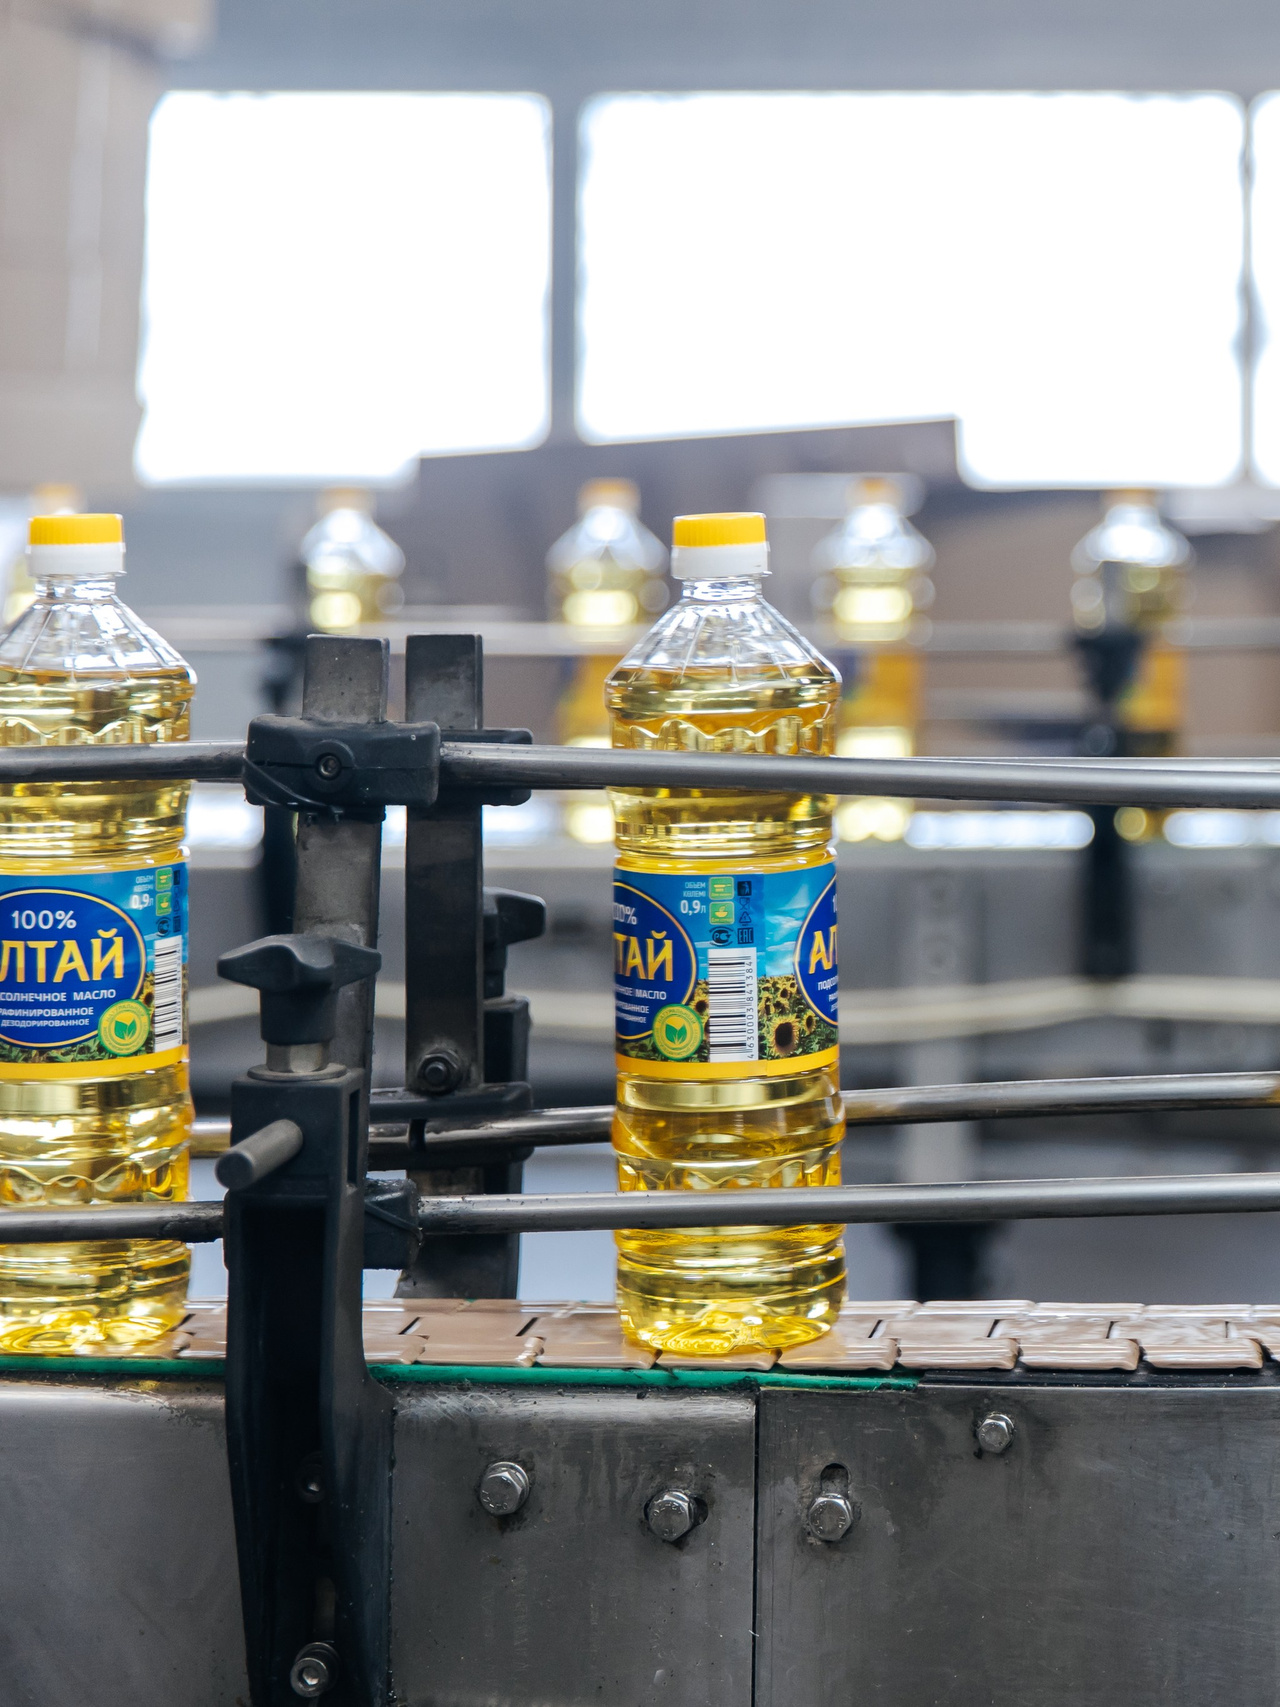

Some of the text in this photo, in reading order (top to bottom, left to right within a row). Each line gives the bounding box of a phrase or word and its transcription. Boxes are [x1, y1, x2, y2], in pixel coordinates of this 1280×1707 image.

[11, 910, 77, 930] 100%
[0, 928, 124, 983] ЛТАЙ
[613, 930, 673, 982] ТАЙ
[0, 989, 116, 1002] СОЛНЕЧНОЕ МАСЛО
[635, 988, 667, 1001] МАСЛО
